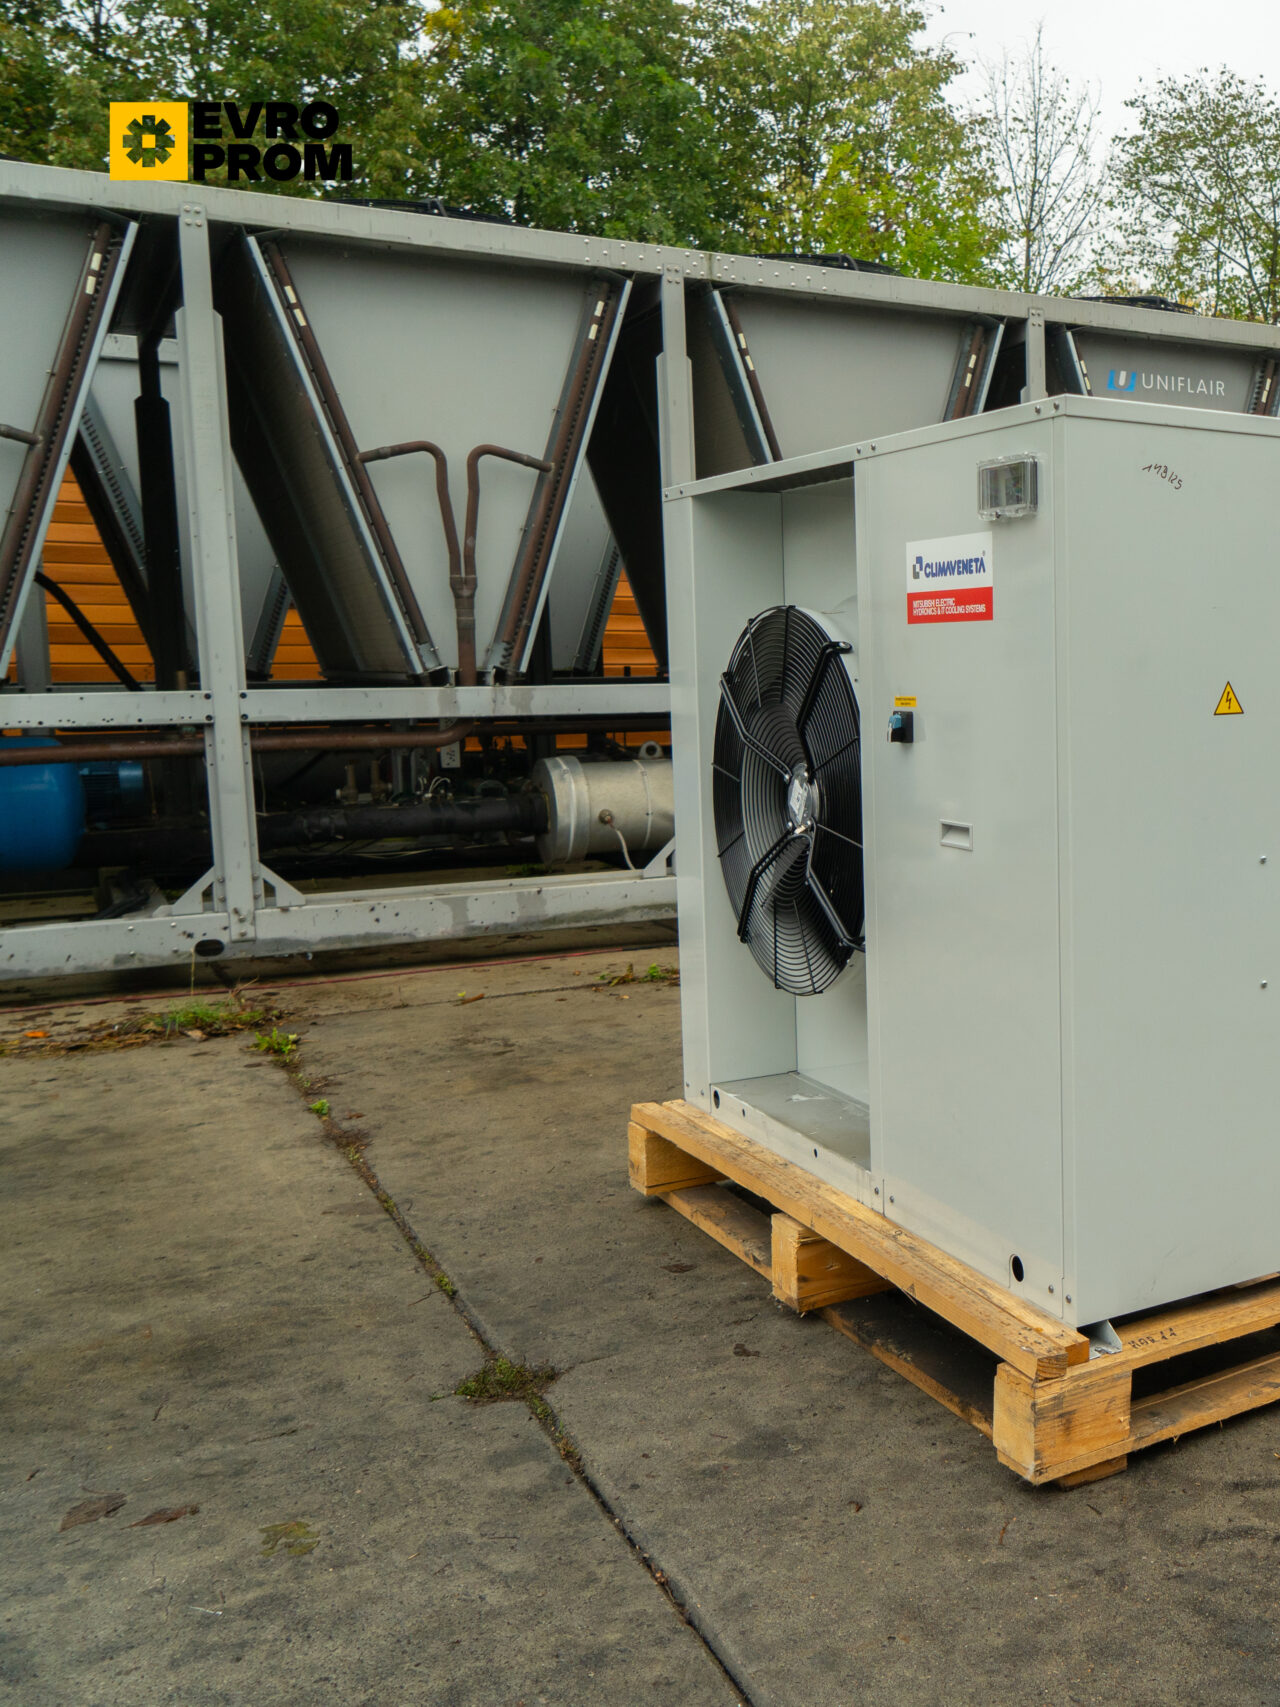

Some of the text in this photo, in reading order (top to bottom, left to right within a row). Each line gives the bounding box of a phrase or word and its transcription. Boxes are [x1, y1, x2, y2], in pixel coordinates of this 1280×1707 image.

[1141, 372, 1225, 396] UNIFLAIR
[924, 557, 986, 578] CLIMAVENETA
[965, 604, 986, 614] SYSTEMS
